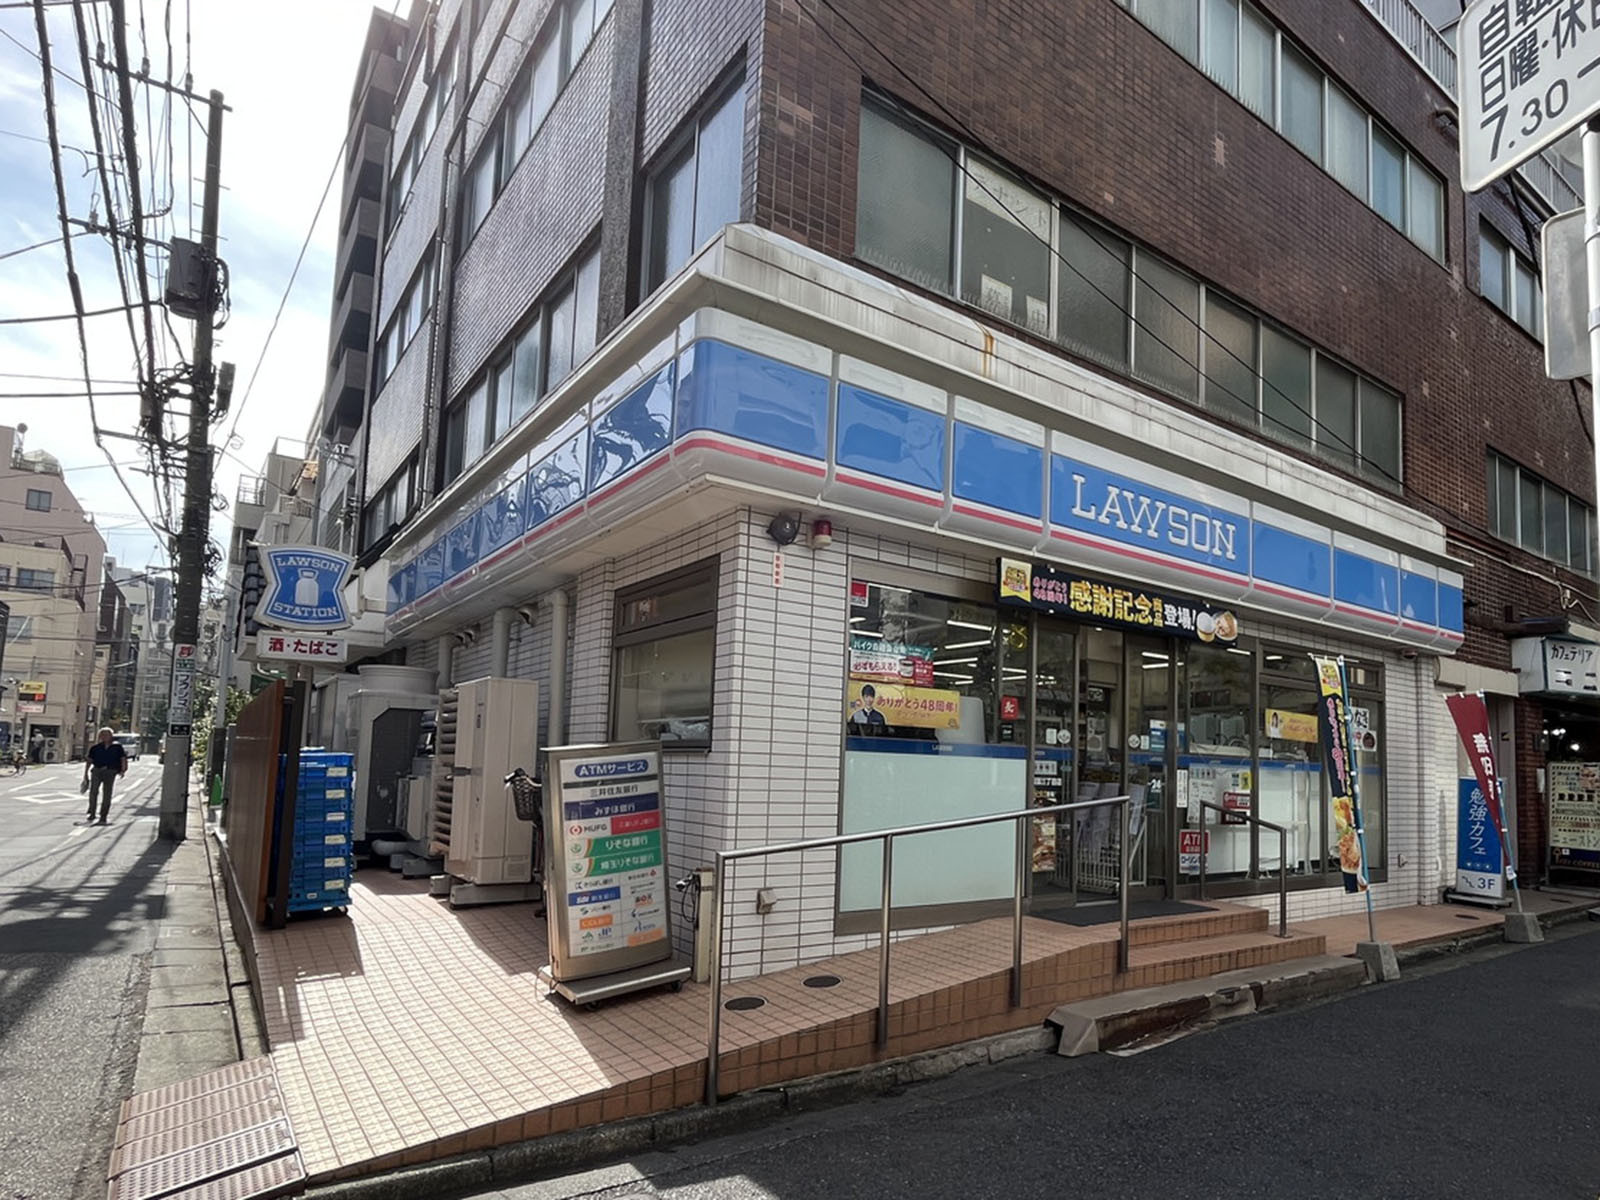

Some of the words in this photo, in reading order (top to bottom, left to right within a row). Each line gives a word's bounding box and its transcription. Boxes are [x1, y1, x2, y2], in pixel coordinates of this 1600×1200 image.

[1481, 0, 1600, 113] 日曜・休
[1071, 474, 1236, 560] LAWSON
[276, 556, 340, 573] LAWSON
[274, 602, 338, 617] STATION
[580, 761, 646, 776] ATMサービス
[584, 824, 608, 833] MUFG
[1469, 787, 1488, 855] 勉強カフェ
[605, 836, 648, 849] りそな銀行
[1478, 877, 1496, 889] 3F
